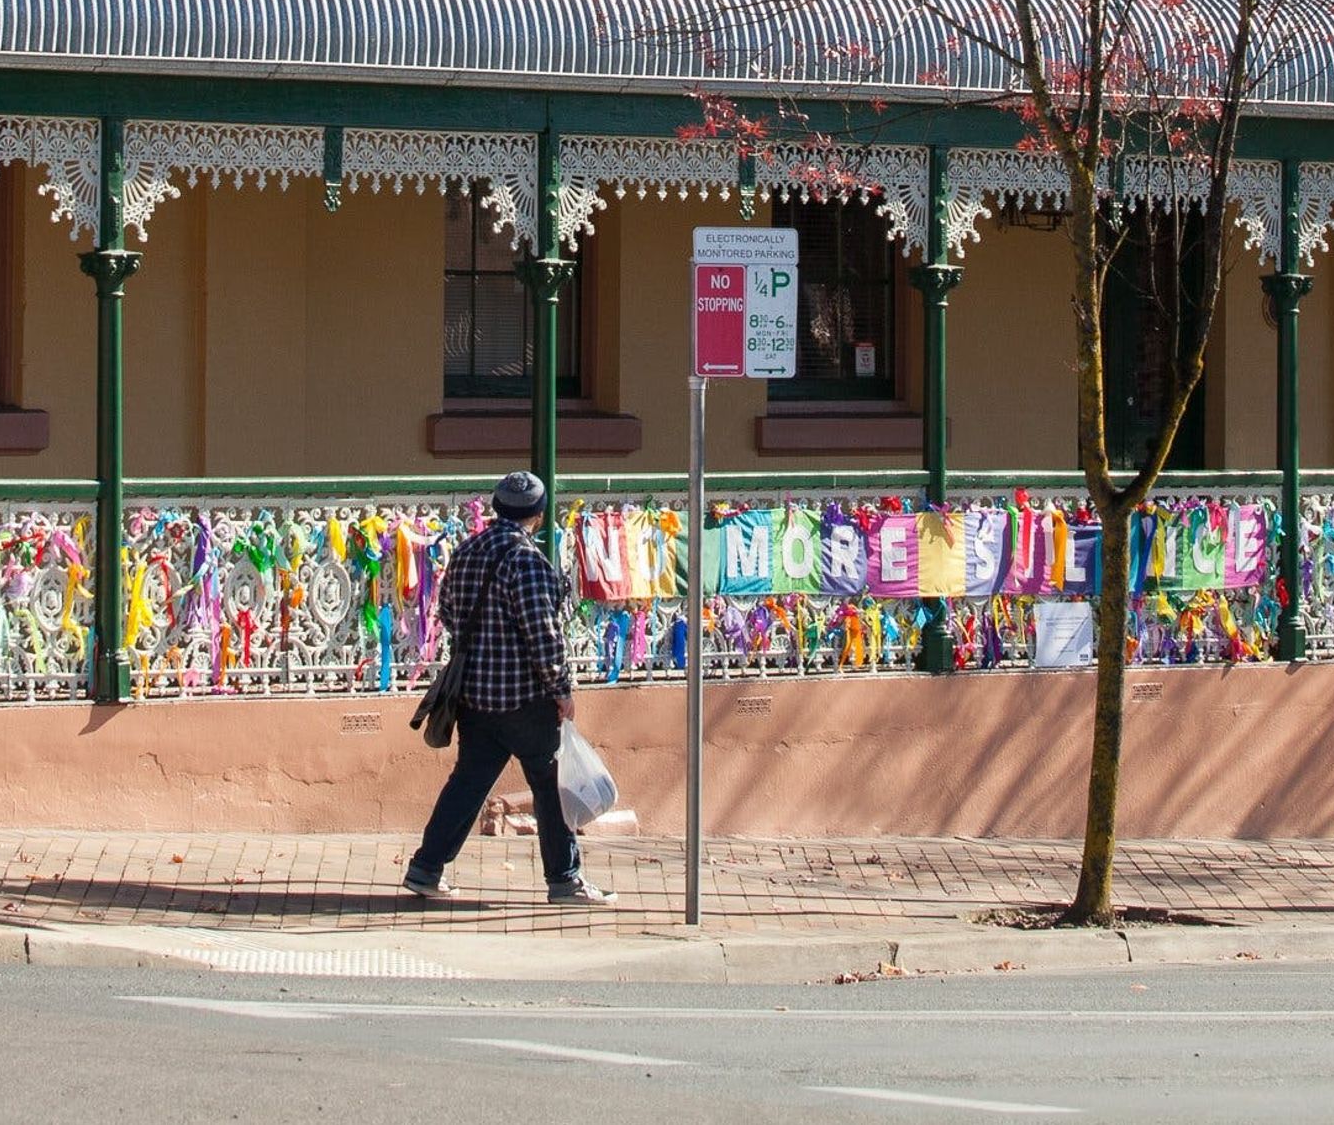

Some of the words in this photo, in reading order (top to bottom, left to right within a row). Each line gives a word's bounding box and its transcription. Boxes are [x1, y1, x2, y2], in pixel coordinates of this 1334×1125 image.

[706, 234, 786, 243] ELECTRONICALLY
[698, 249, 753, 259] MONITORED
[755, 249, 795, 259] PARKING
[710, 275, 730, 289] NO
[698, 297, 743, 312] STOPPING
[583, 525, 667, 582] NO
[725, 524, 908, 583] MORE
